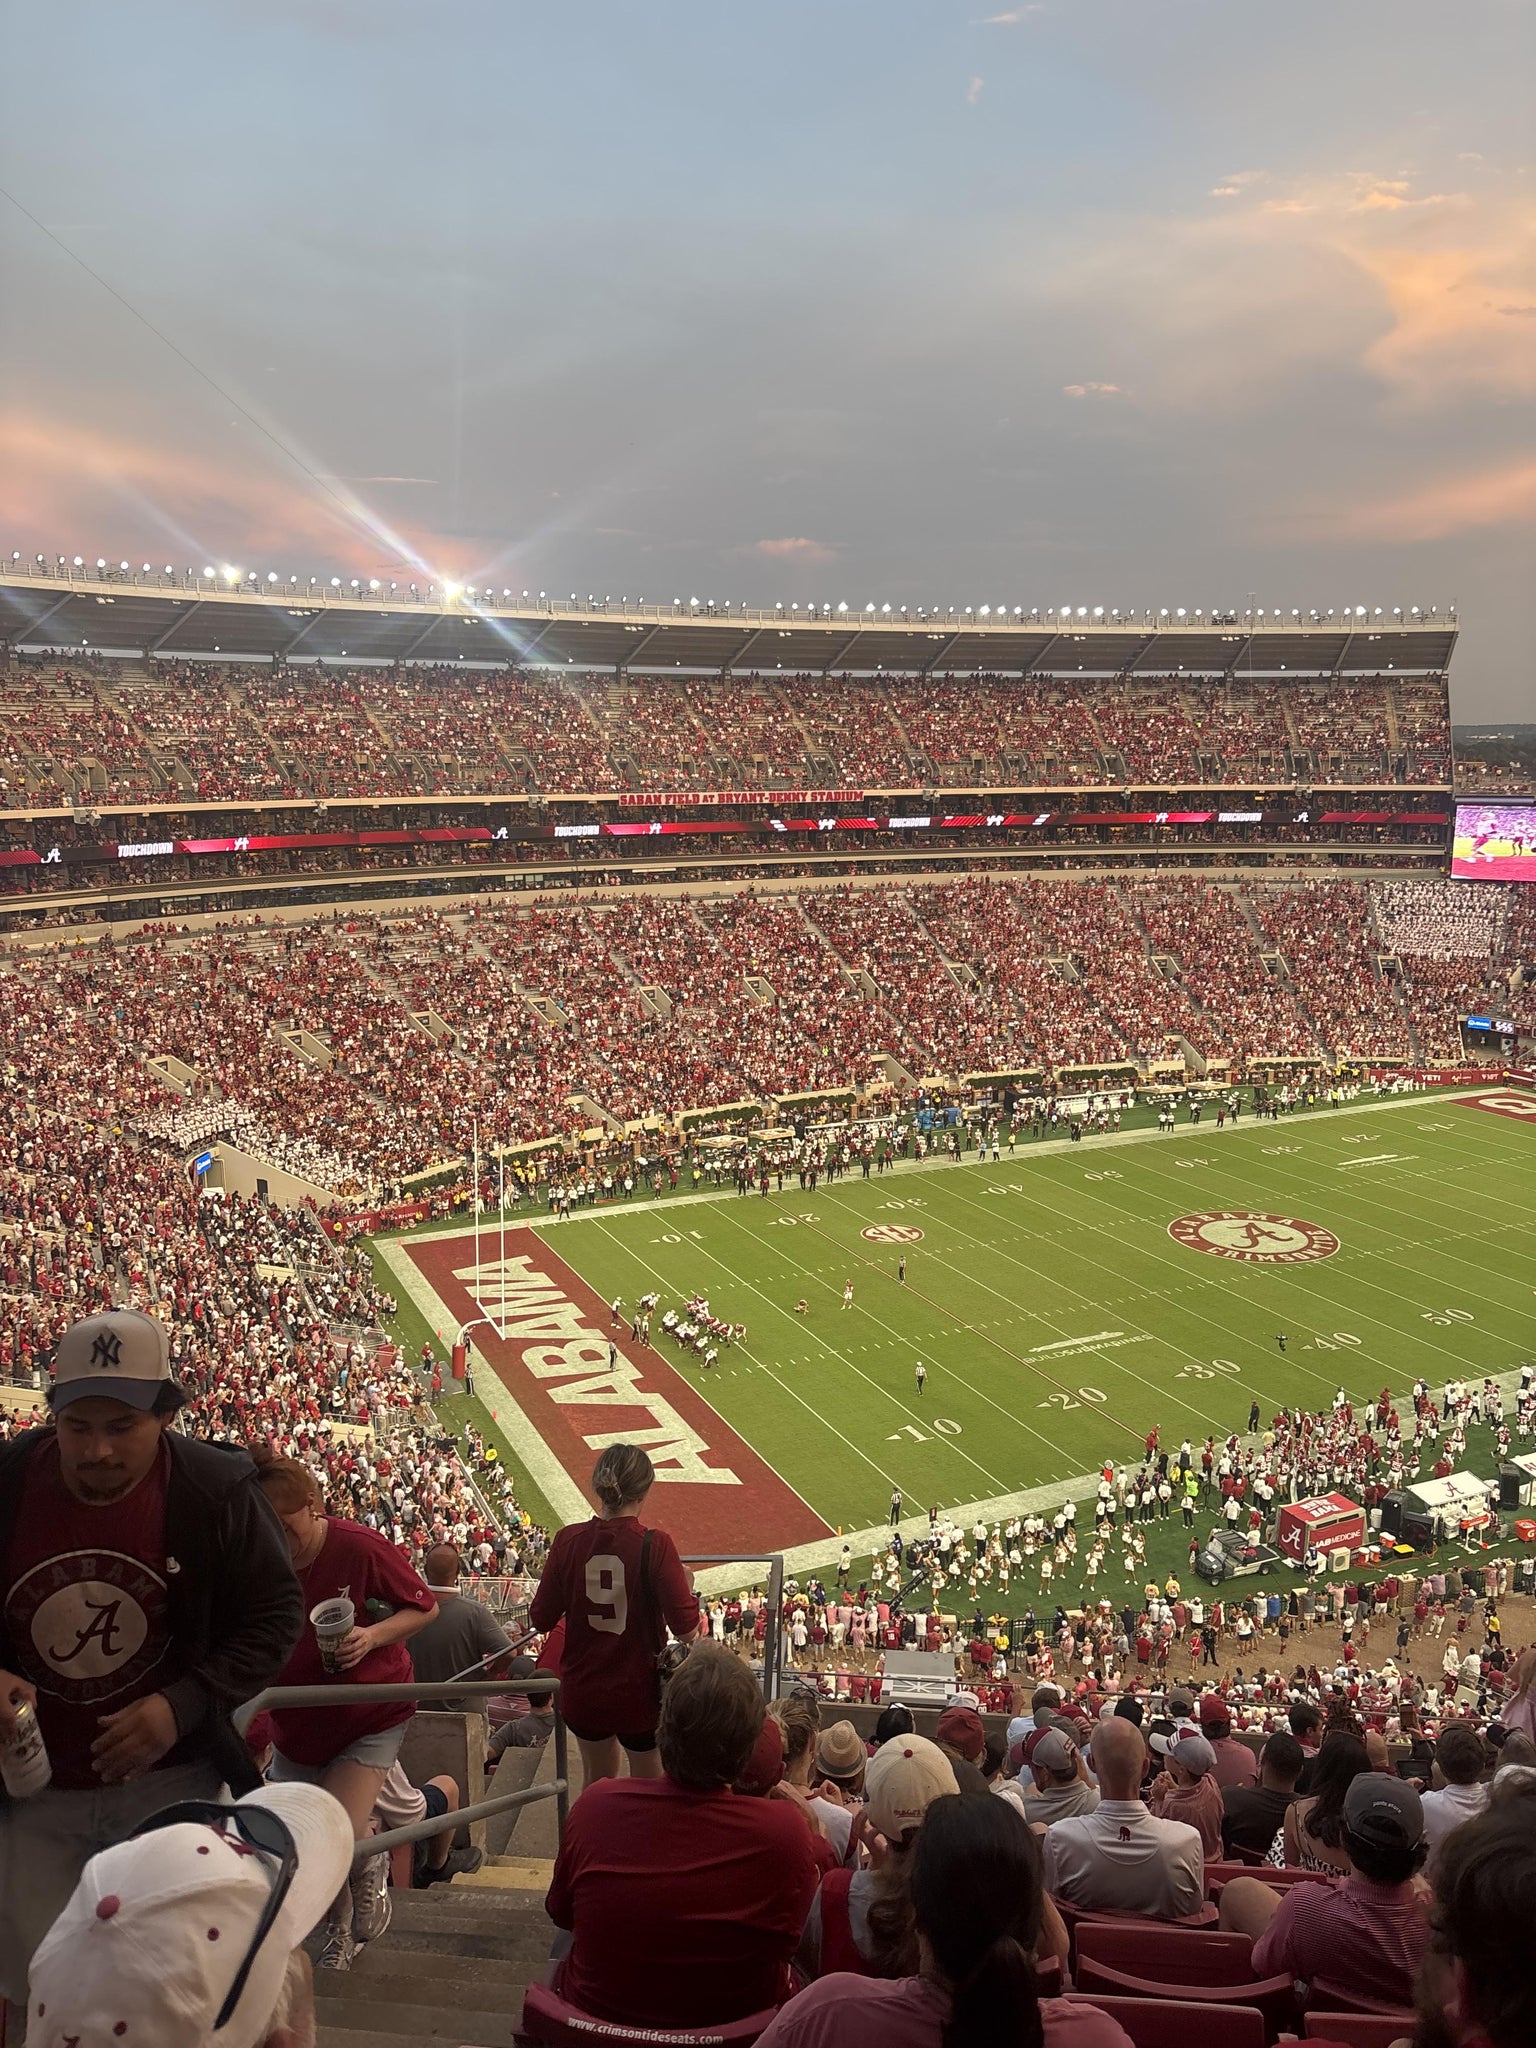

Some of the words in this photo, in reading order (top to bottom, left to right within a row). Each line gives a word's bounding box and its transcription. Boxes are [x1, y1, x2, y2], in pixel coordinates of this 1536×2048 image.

[620, 794, 662, 805] SABAN
[665, 793, 700, 804] FIELD
[703, 795, 715, 803] AT
[717, 792, 808, 803] BRYANT-DENNY
[810, 791, 864, 802] STADIUM
[888, 817, 931, 828] TOUCHDOWN
[1218, 812, 1262, 822] TOUCHDOWN
[554, 824, 600, 837] TOUCHDOWN
[117, 841, 173, 858] TOUCHDOWN
[1175, 1158, 1210, 1168] 40
[1084, 1170, 1124, 1181] 50
[987, 1183, 1024, 1195] 40
[886, 1198, 928, 1209] 30
[778, 1213, 821, 1226] 20
[1174, 1212, 1295, 1242] ALABAMA
[661, 1230, 707, 1244] 10
[865, 1225, 920, 1243] SEC
[1226, 1222, 1294, 1249] A
[1307, 1229, 1335, 1250] TIDE
[1206, 1247, 1325, 1263] CRIMSON
[1420, 1308, 1475, 1326] 50
[90, 1332, 123, 1368] NY
[1023, 1334, 1153, 1364] BUILDSUBMARINES
[1314, 1332, 1363, 1350] 40
[451, 1254, 744, 1485] ALABAMA
[1184, 1359, 1242, 1379] 30
[1048, 1387, 1109, 1410] 20
[898, 1418, 964, 1443] 10
[1440, 1481, 1465, 1497] A
[1281, 1524, 1301, 1550] A
[1331, 1529, 1362, 1544] MEDICINE
[585, 1554, 628, 1635] 9
[49, 1599, 124, 1662] A
[568, 2016, 724, 2045] www.crimsontideseats.com
